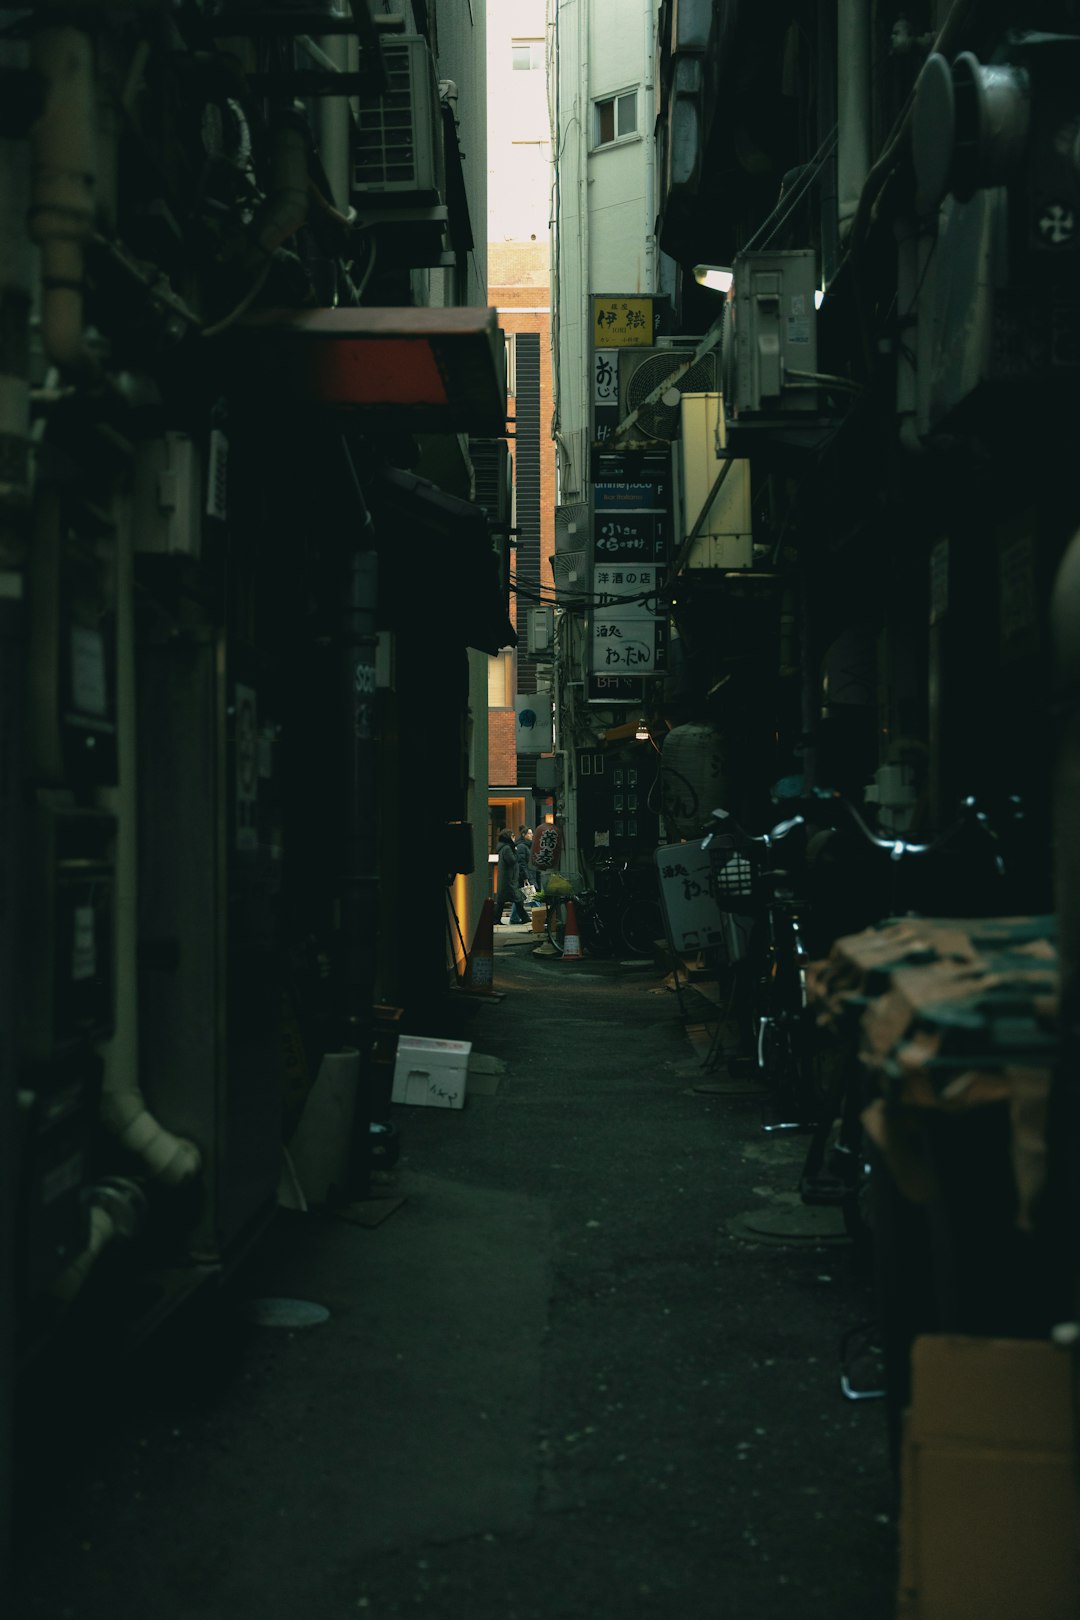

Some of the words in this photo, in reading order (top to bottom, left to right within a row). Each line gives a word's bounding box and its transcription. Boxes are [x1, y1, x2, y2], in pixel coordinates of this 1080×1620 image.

[597, 309, 646, 330] 伊織
[598, 572, 651, 584] 洋酒の店
[596, 625, 623, 638] 酒処
[656, 629, 665, 661] 1F
